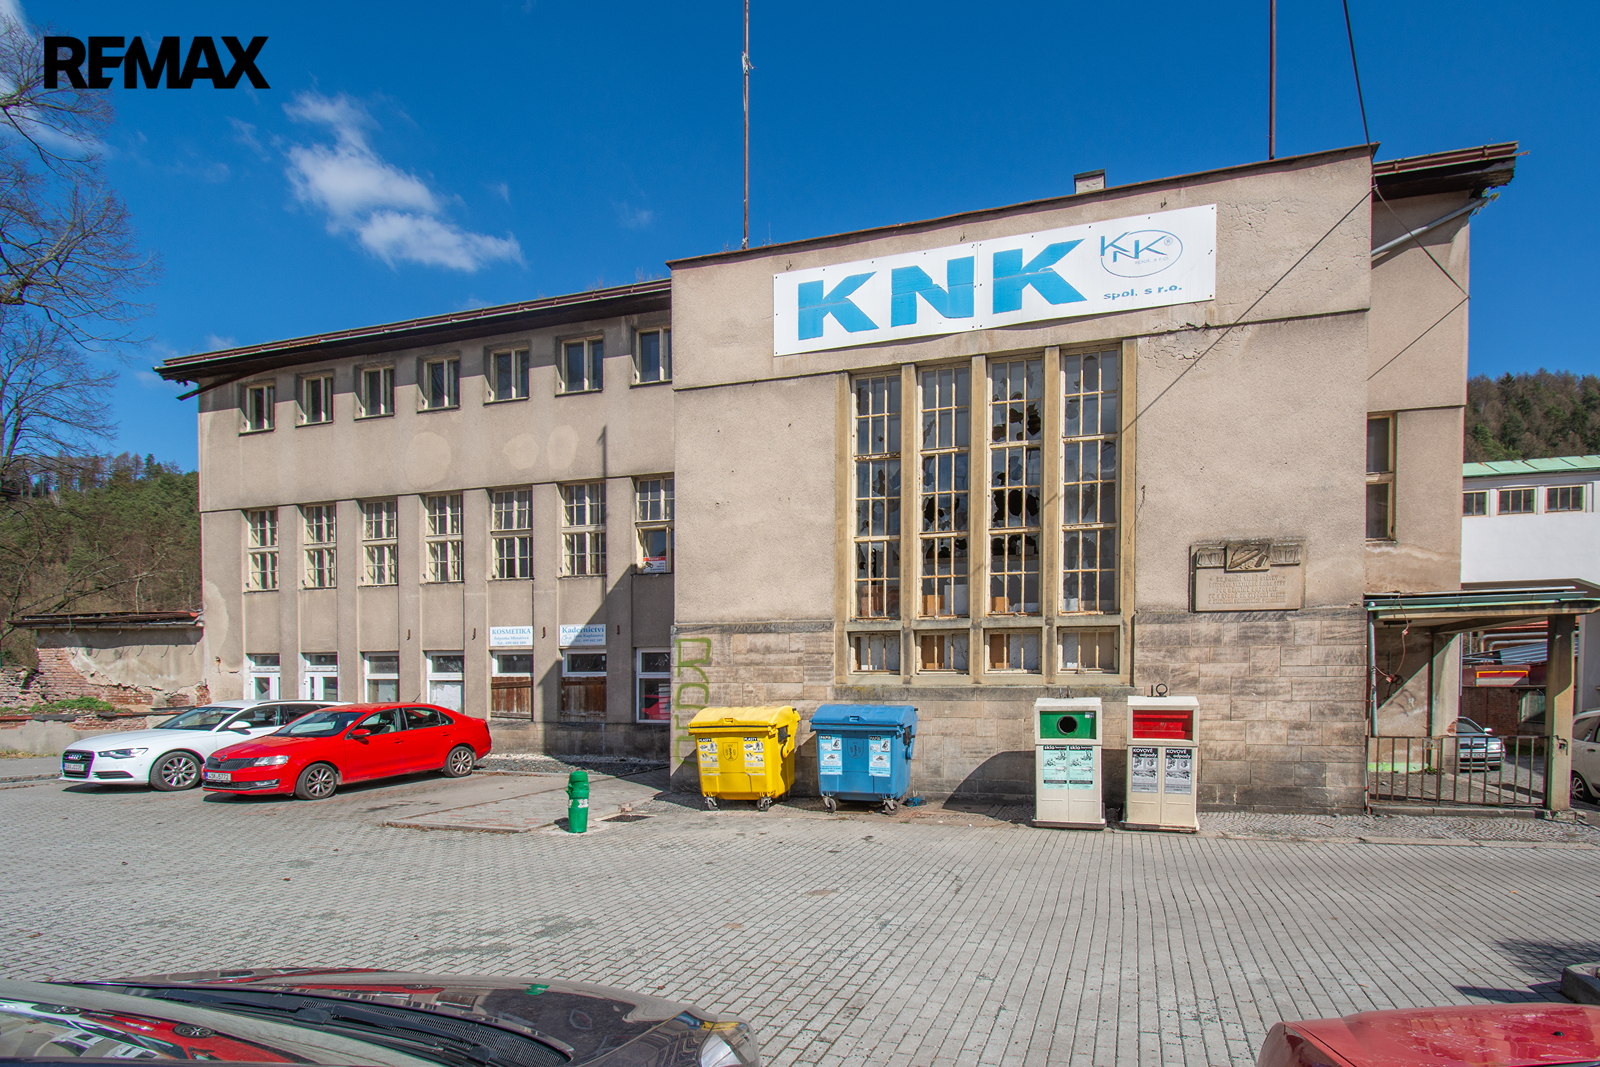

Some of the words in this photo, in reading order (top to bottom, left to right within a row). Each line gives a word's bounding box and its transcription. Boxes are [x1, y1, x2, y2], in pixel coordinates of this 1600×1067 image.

[797, 239, 1087, 340] KNK
[1103, 288, 1138, 301] spol.
[1144, 287, 1153, 295] s
[1158, 284, 1183, 294] r.o.
